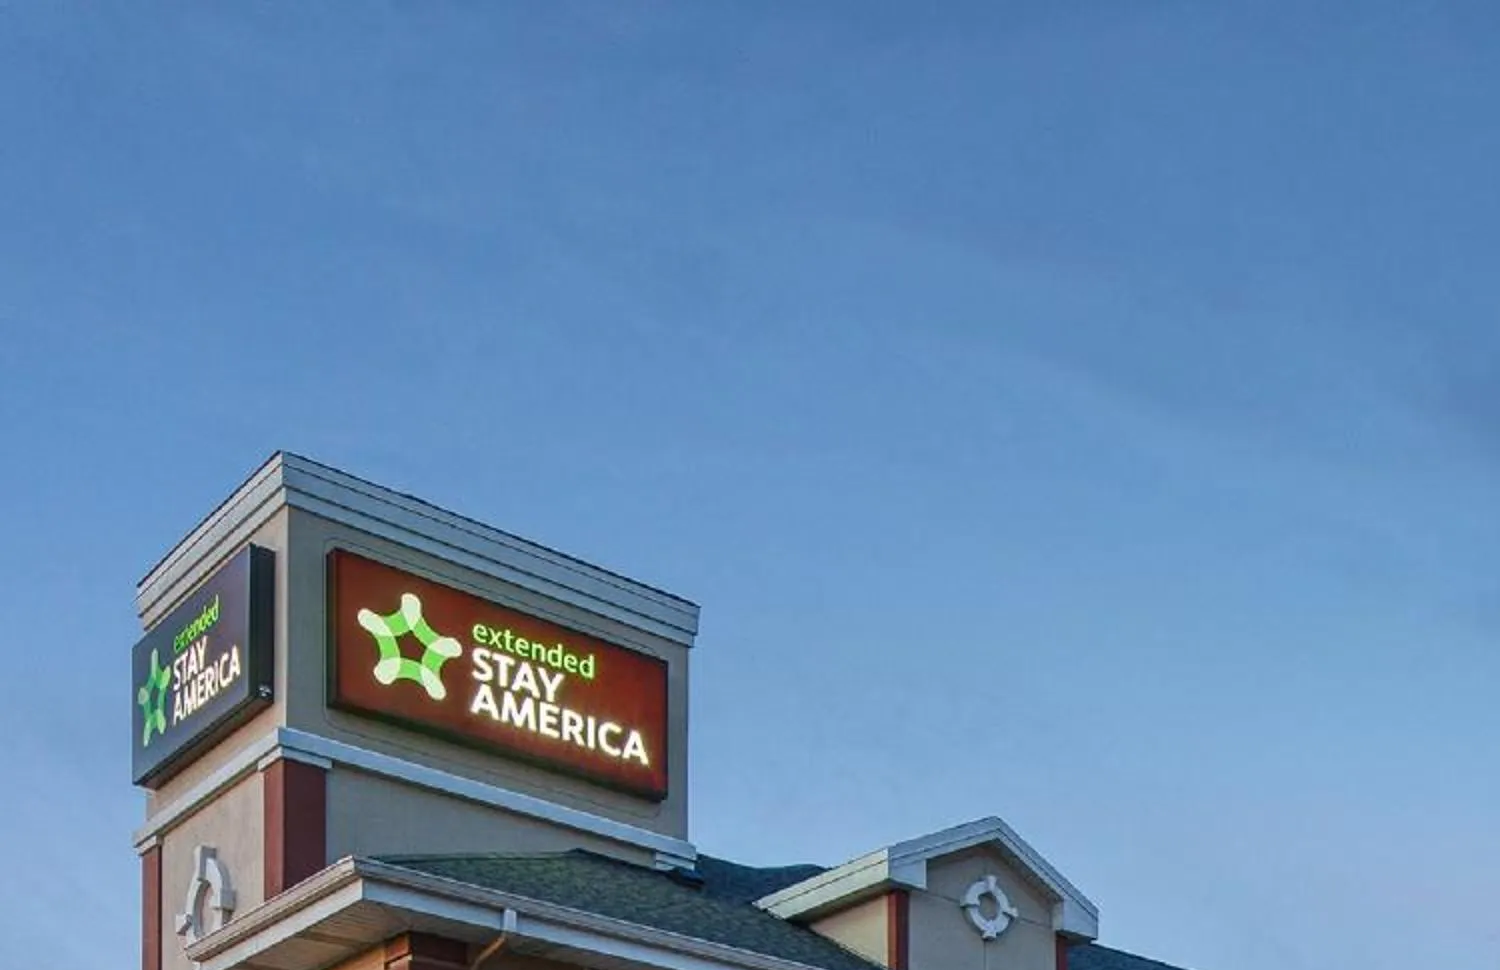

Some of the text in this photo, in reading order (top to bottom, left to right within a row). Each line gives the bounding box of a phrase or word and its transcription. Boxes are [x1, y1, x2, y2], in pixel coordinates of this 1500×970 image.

[173, 593, 219, 653] extended
[472, 624, 595, 679] extended
[172, 635, 207, 691] STAY
[173, 644, 240, 726] AMERICA
[472, 648, 565, 703] STAY
[469, 683, 650, 766] AMERICA
